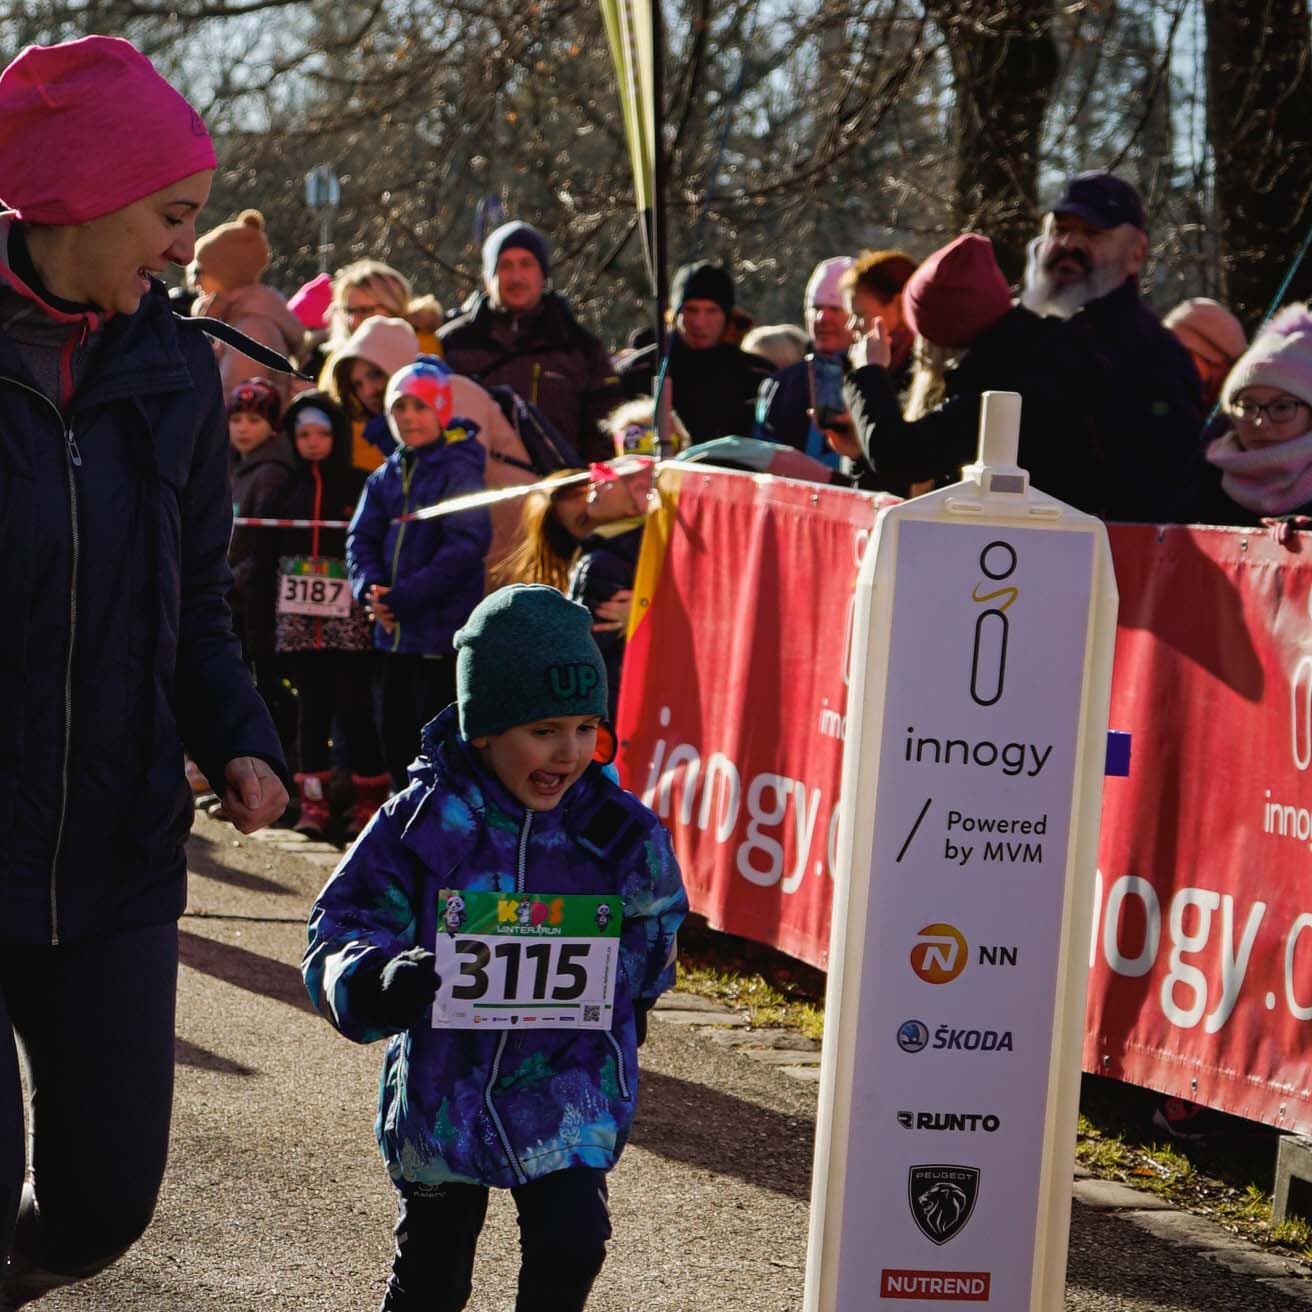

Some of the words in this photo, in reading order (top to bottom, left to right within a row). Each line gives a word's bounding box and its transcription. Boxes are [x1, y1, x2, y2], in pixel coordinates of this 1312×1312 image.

[285, 578, 343, 603] 3187
[548, 664, 598, 698] UP
[905, 726, 1053, 777] innogy
[947, 810, 1048, 835] Powered
[1264, 789, 1312, 854] inno
[944, 838, 974, 866] by
[983, 841, 1043, 864] MVM
[979, 945, 1018, 967] NN
[451, 940, 592, 1001] 3115
[933, 1024, 1014, 1052] ŠKODA
[916, 1112, 1001, 1132] RUNTO
[916, 1171, 974, 1181] PEUGEOT
[887, 1276, 985, 1295] NUTREND
